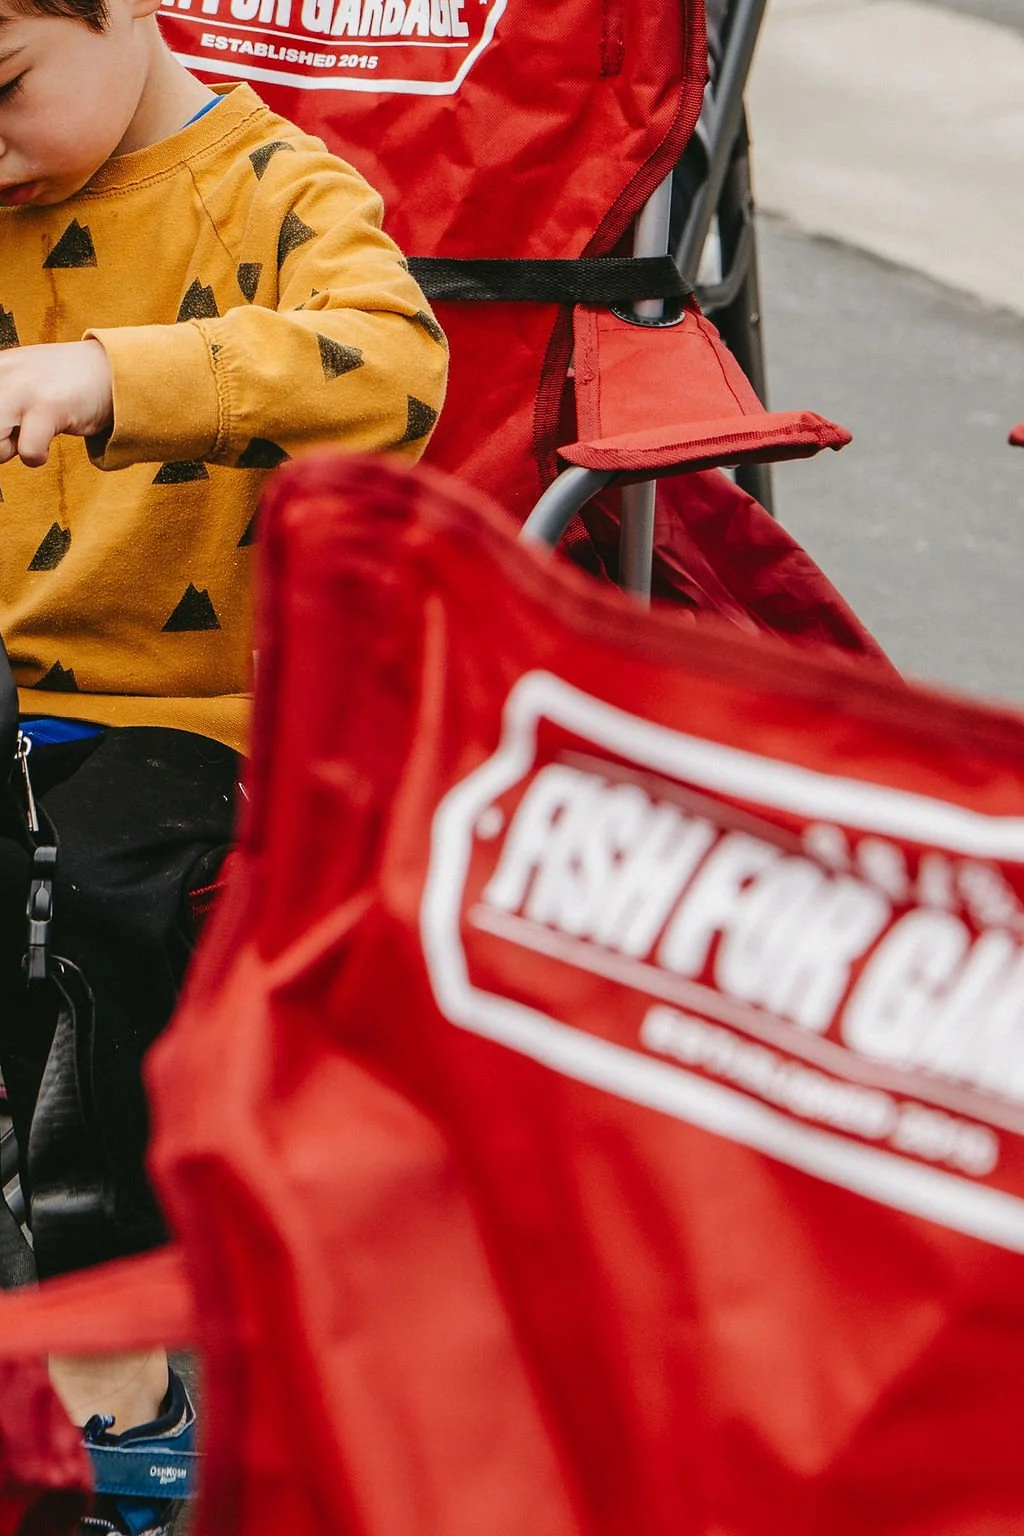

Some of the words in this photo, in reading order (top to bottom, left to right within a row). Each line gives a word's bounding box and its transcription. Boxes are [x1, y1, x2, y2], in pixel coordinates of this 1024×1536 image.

[200, 33, 336, 68] ESTABLISHED
[337, 54, 378, 69] 2015
[480, 762, 719, 961] FISH
[657, 830, 891, 1036] FOR
